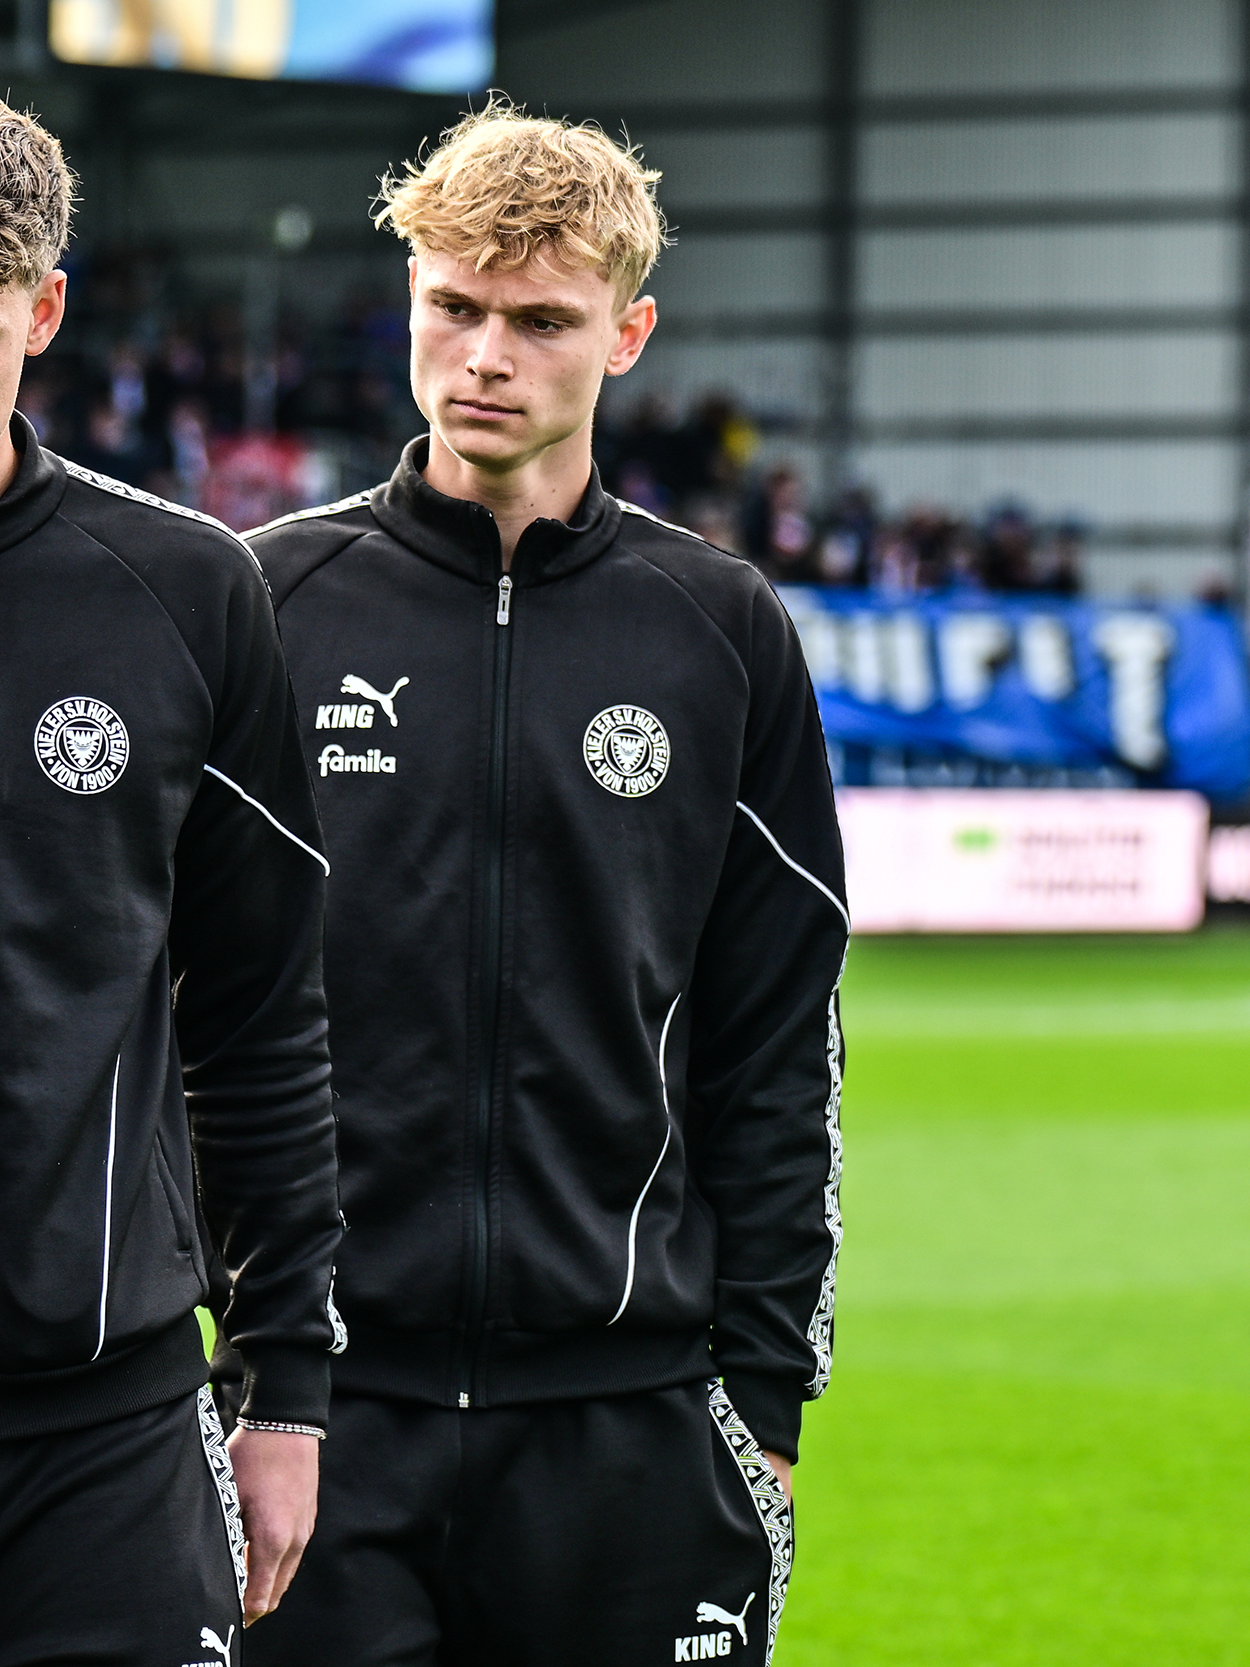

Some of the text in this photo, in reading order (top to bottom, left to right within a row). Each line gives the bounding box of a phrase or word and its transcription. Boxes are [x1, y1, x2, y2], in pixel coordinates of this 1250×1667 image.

[315, 704, 375, 729] KING
[38, 707, 69, 759] KIELER
[86, 702, 126, 766] HOLSTEIN
[586, 714, 616, 761] KIELER
[633, 711, 667, 773] HOLSTEIN
[50, 759, 114, 790] VON 1900
[318, 744, 396, 777] famila
[595, 762, 656, 793] VON 1900
[675, 1631, 732, 1662] KING
